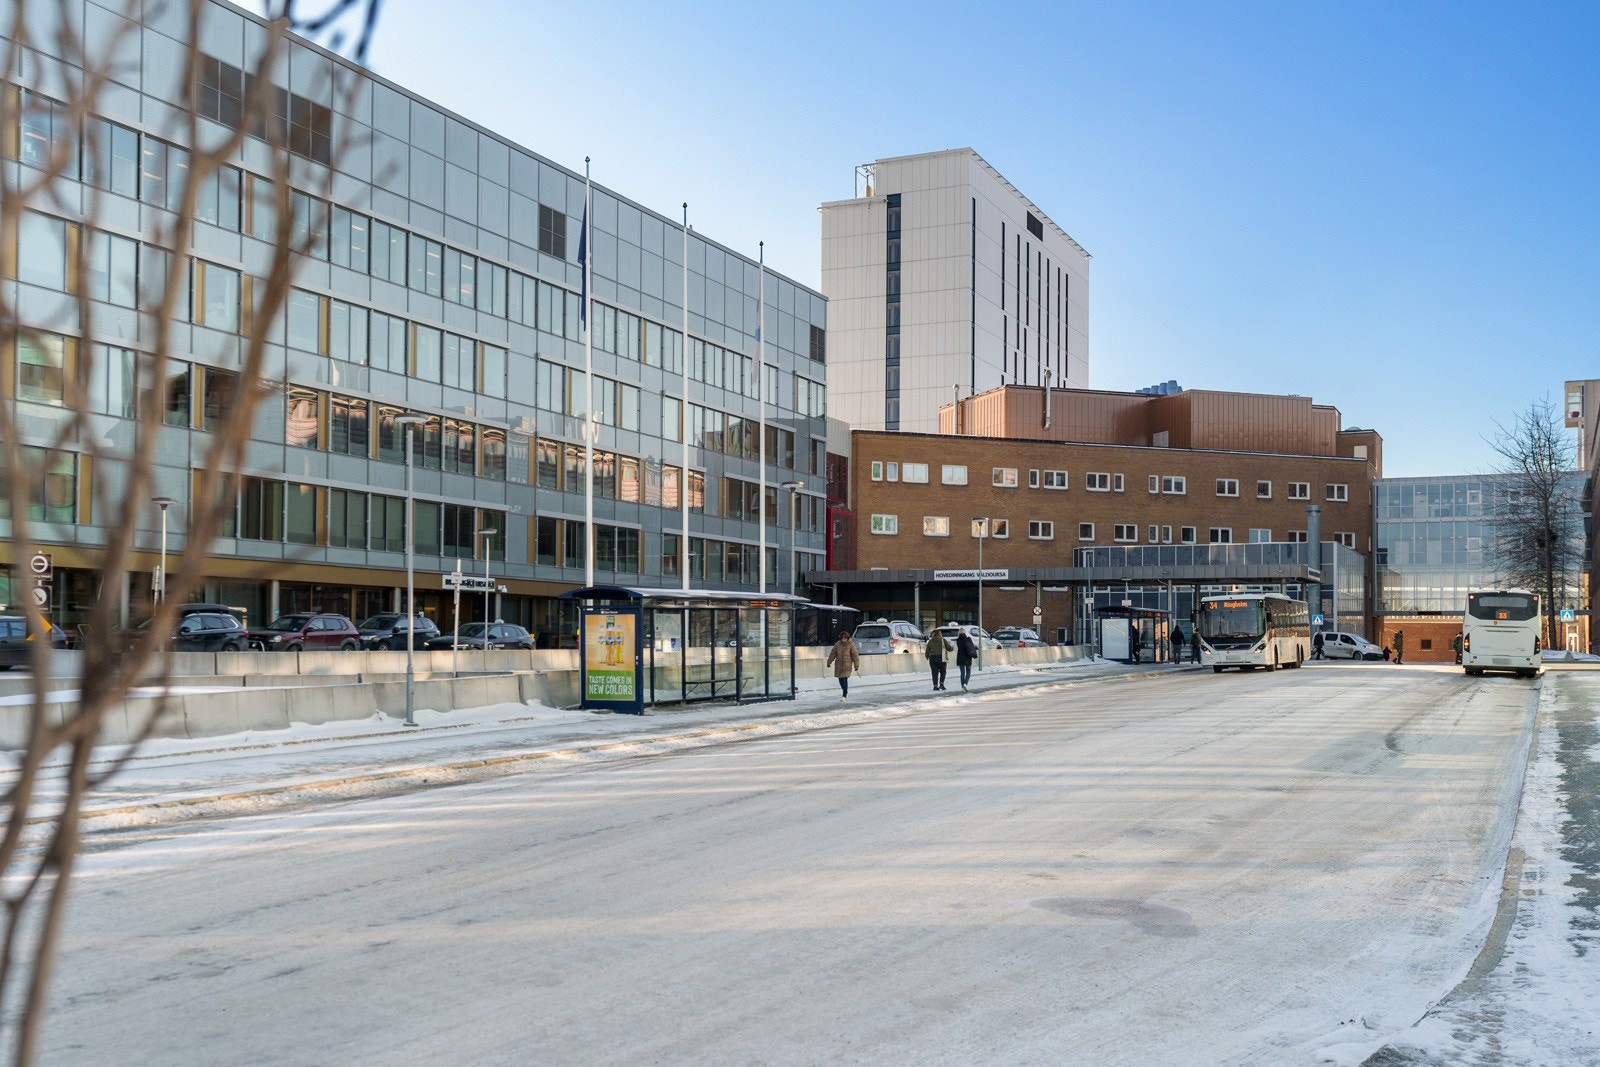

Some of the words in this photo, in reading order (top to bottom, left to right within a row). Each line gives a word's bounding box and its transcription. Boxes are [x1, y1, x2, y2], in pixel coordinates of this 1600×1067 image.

[1209, 601, 1218, 609] 34
[588, 675, 605, 684] TASTE
[605, 675, 625, 684] COMES
[625, 676, 632, 684] IN
[588, 684, 604, 695] NEW
[605, 685, 633, 695] COLORS
